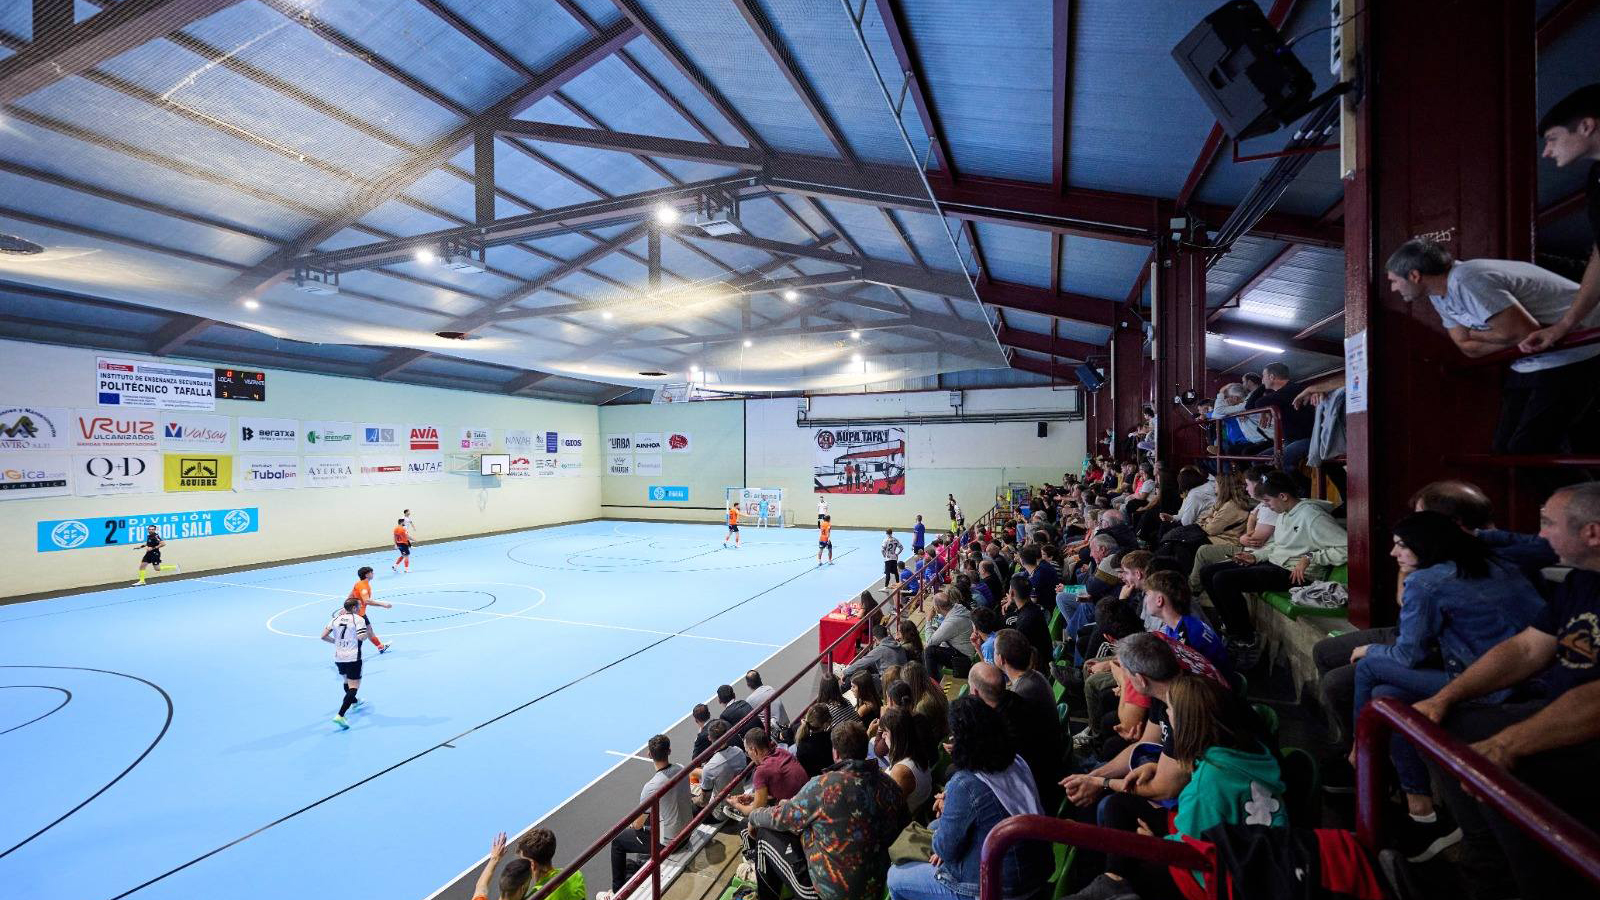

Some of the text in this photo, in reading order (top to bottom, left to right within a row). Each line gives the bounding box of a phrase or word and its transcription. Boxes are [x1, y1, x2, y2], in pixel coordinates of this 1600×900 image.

[100, 373, 133, 381] INSTITUTO
[100, 381, 212, 397] POLITÉCNICO TAFALLA
[128, 513, 212, 525] DIVISIÓN
[182, 520, 212, 538] SALA
[339, 623, 348, 640] 7
